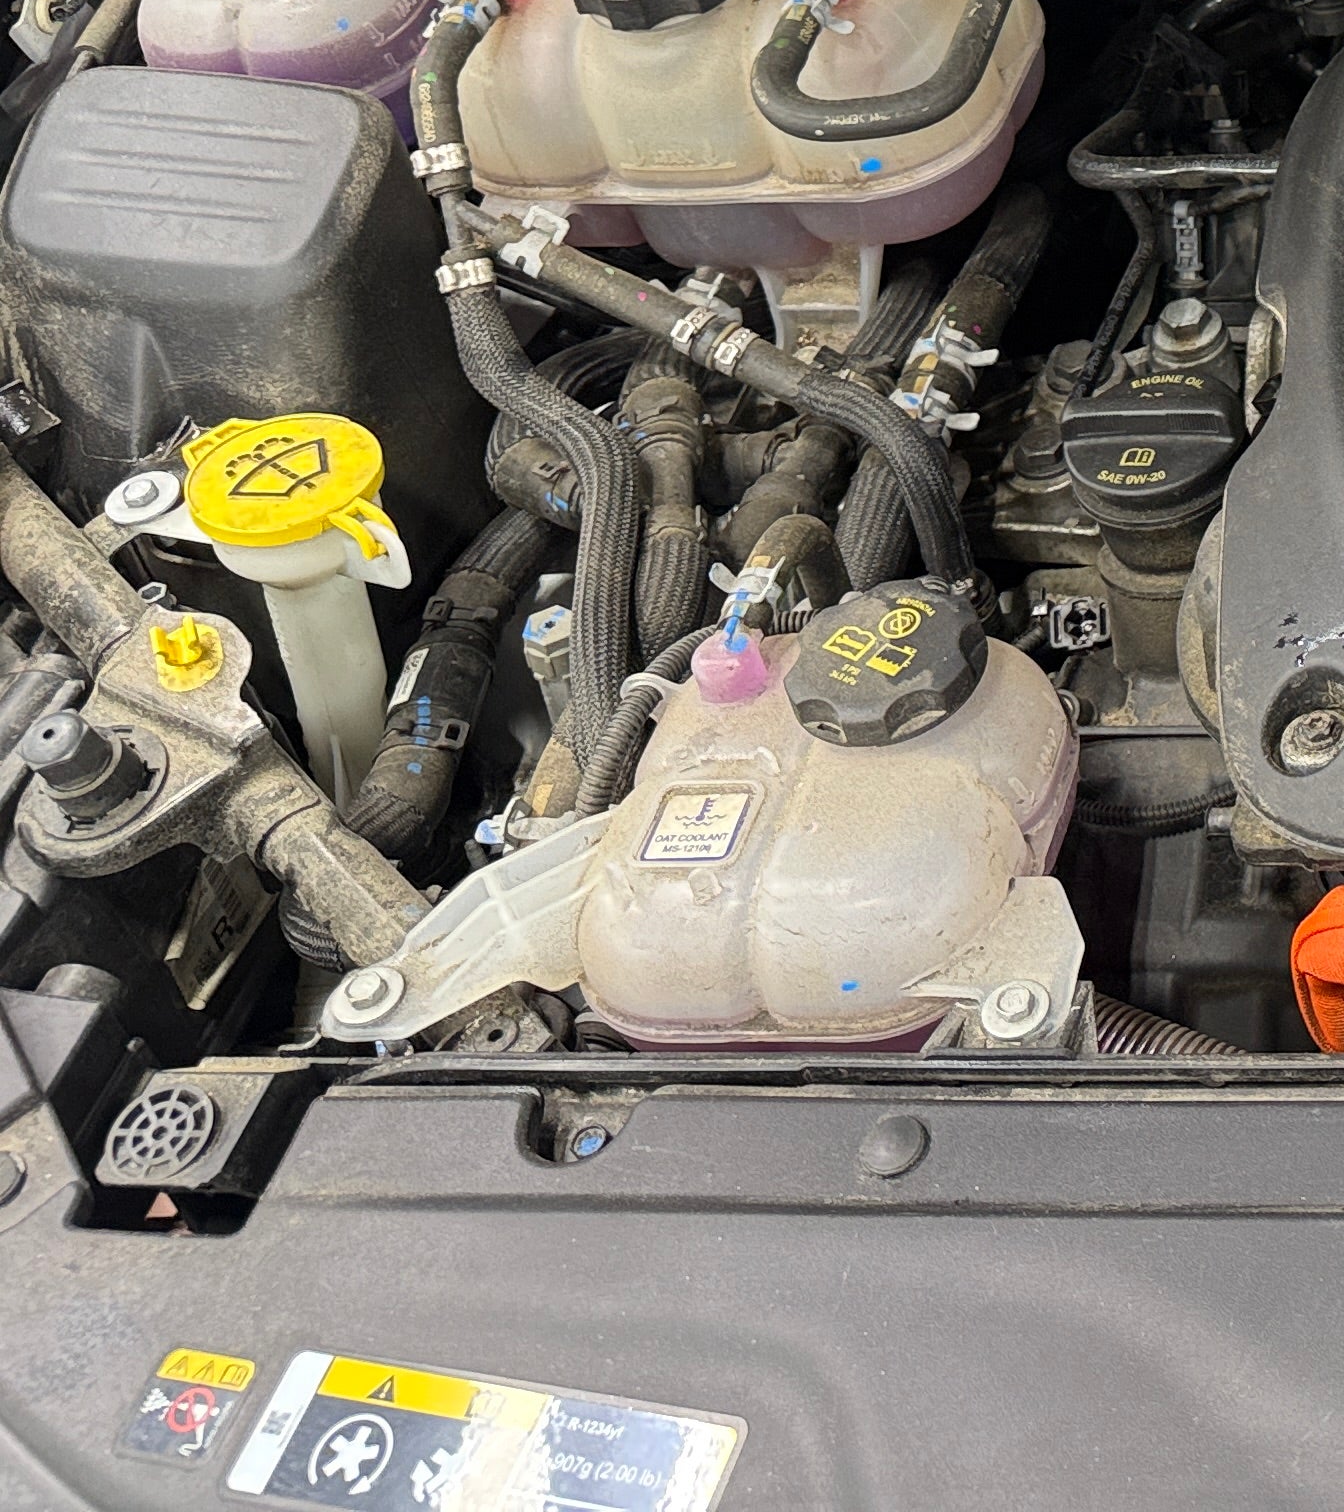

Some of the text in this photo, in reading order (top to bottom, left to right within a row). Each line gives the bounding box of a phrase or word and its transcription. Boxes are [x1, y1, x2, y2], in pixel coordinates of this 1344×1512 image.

[1131, 374, 1205, 389] ENGINE OIL
[1097, 470, 1167, 485] SAE 0W-20
[655, 832, 730, 843] OAT COOLANT
[211, 915, 234, 952] R
[594, 1461, 638, 1484] (2.00
[638, 1470, 663, 1489] lb)
